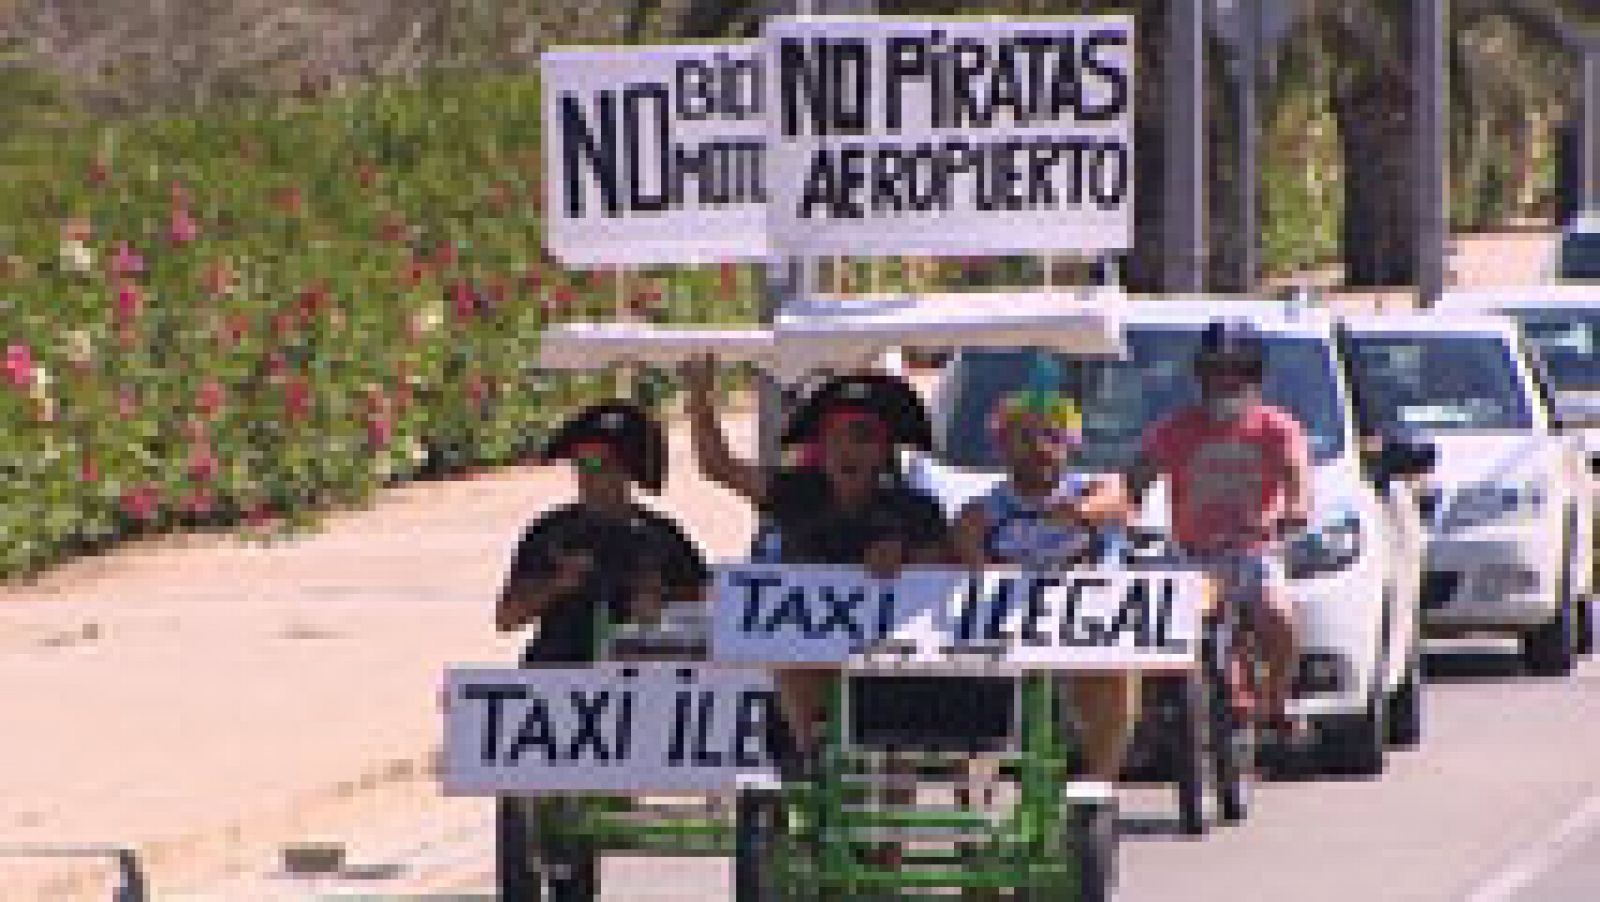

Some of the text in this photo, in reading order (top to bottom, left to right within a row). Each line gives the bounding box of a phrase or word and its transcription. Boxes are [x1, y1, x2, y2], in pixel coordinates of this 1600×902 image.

[779, 36, 868, 136] NO
[560, 83, 671, 219] NO
[797, 136, 1128, 219] AEROPUERTO
